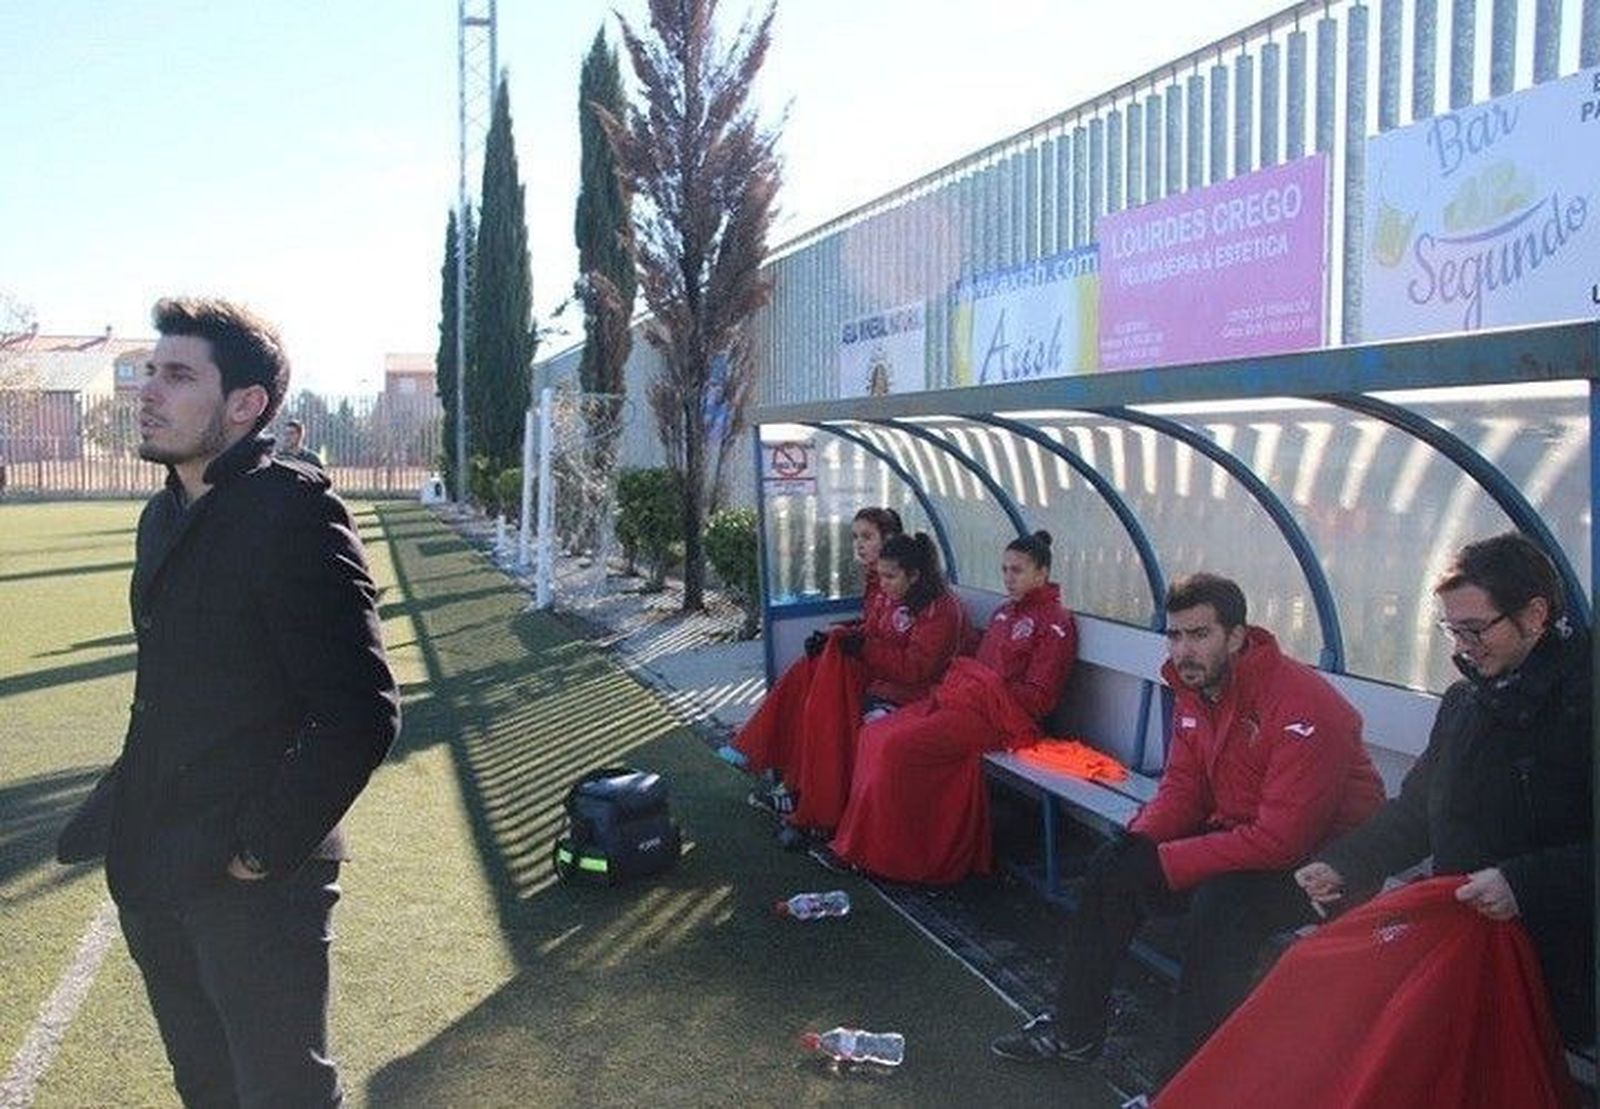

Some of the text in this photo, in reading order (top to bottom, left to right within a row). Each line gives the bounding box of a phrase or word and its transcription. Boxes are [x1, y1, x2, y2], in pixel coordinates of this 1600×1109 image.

[1427, 104, 1519, 177] Bar
[1111, 182, 1302, 258] LOURDES CREGO
[1407, 191, 1588, 331] Segundo
